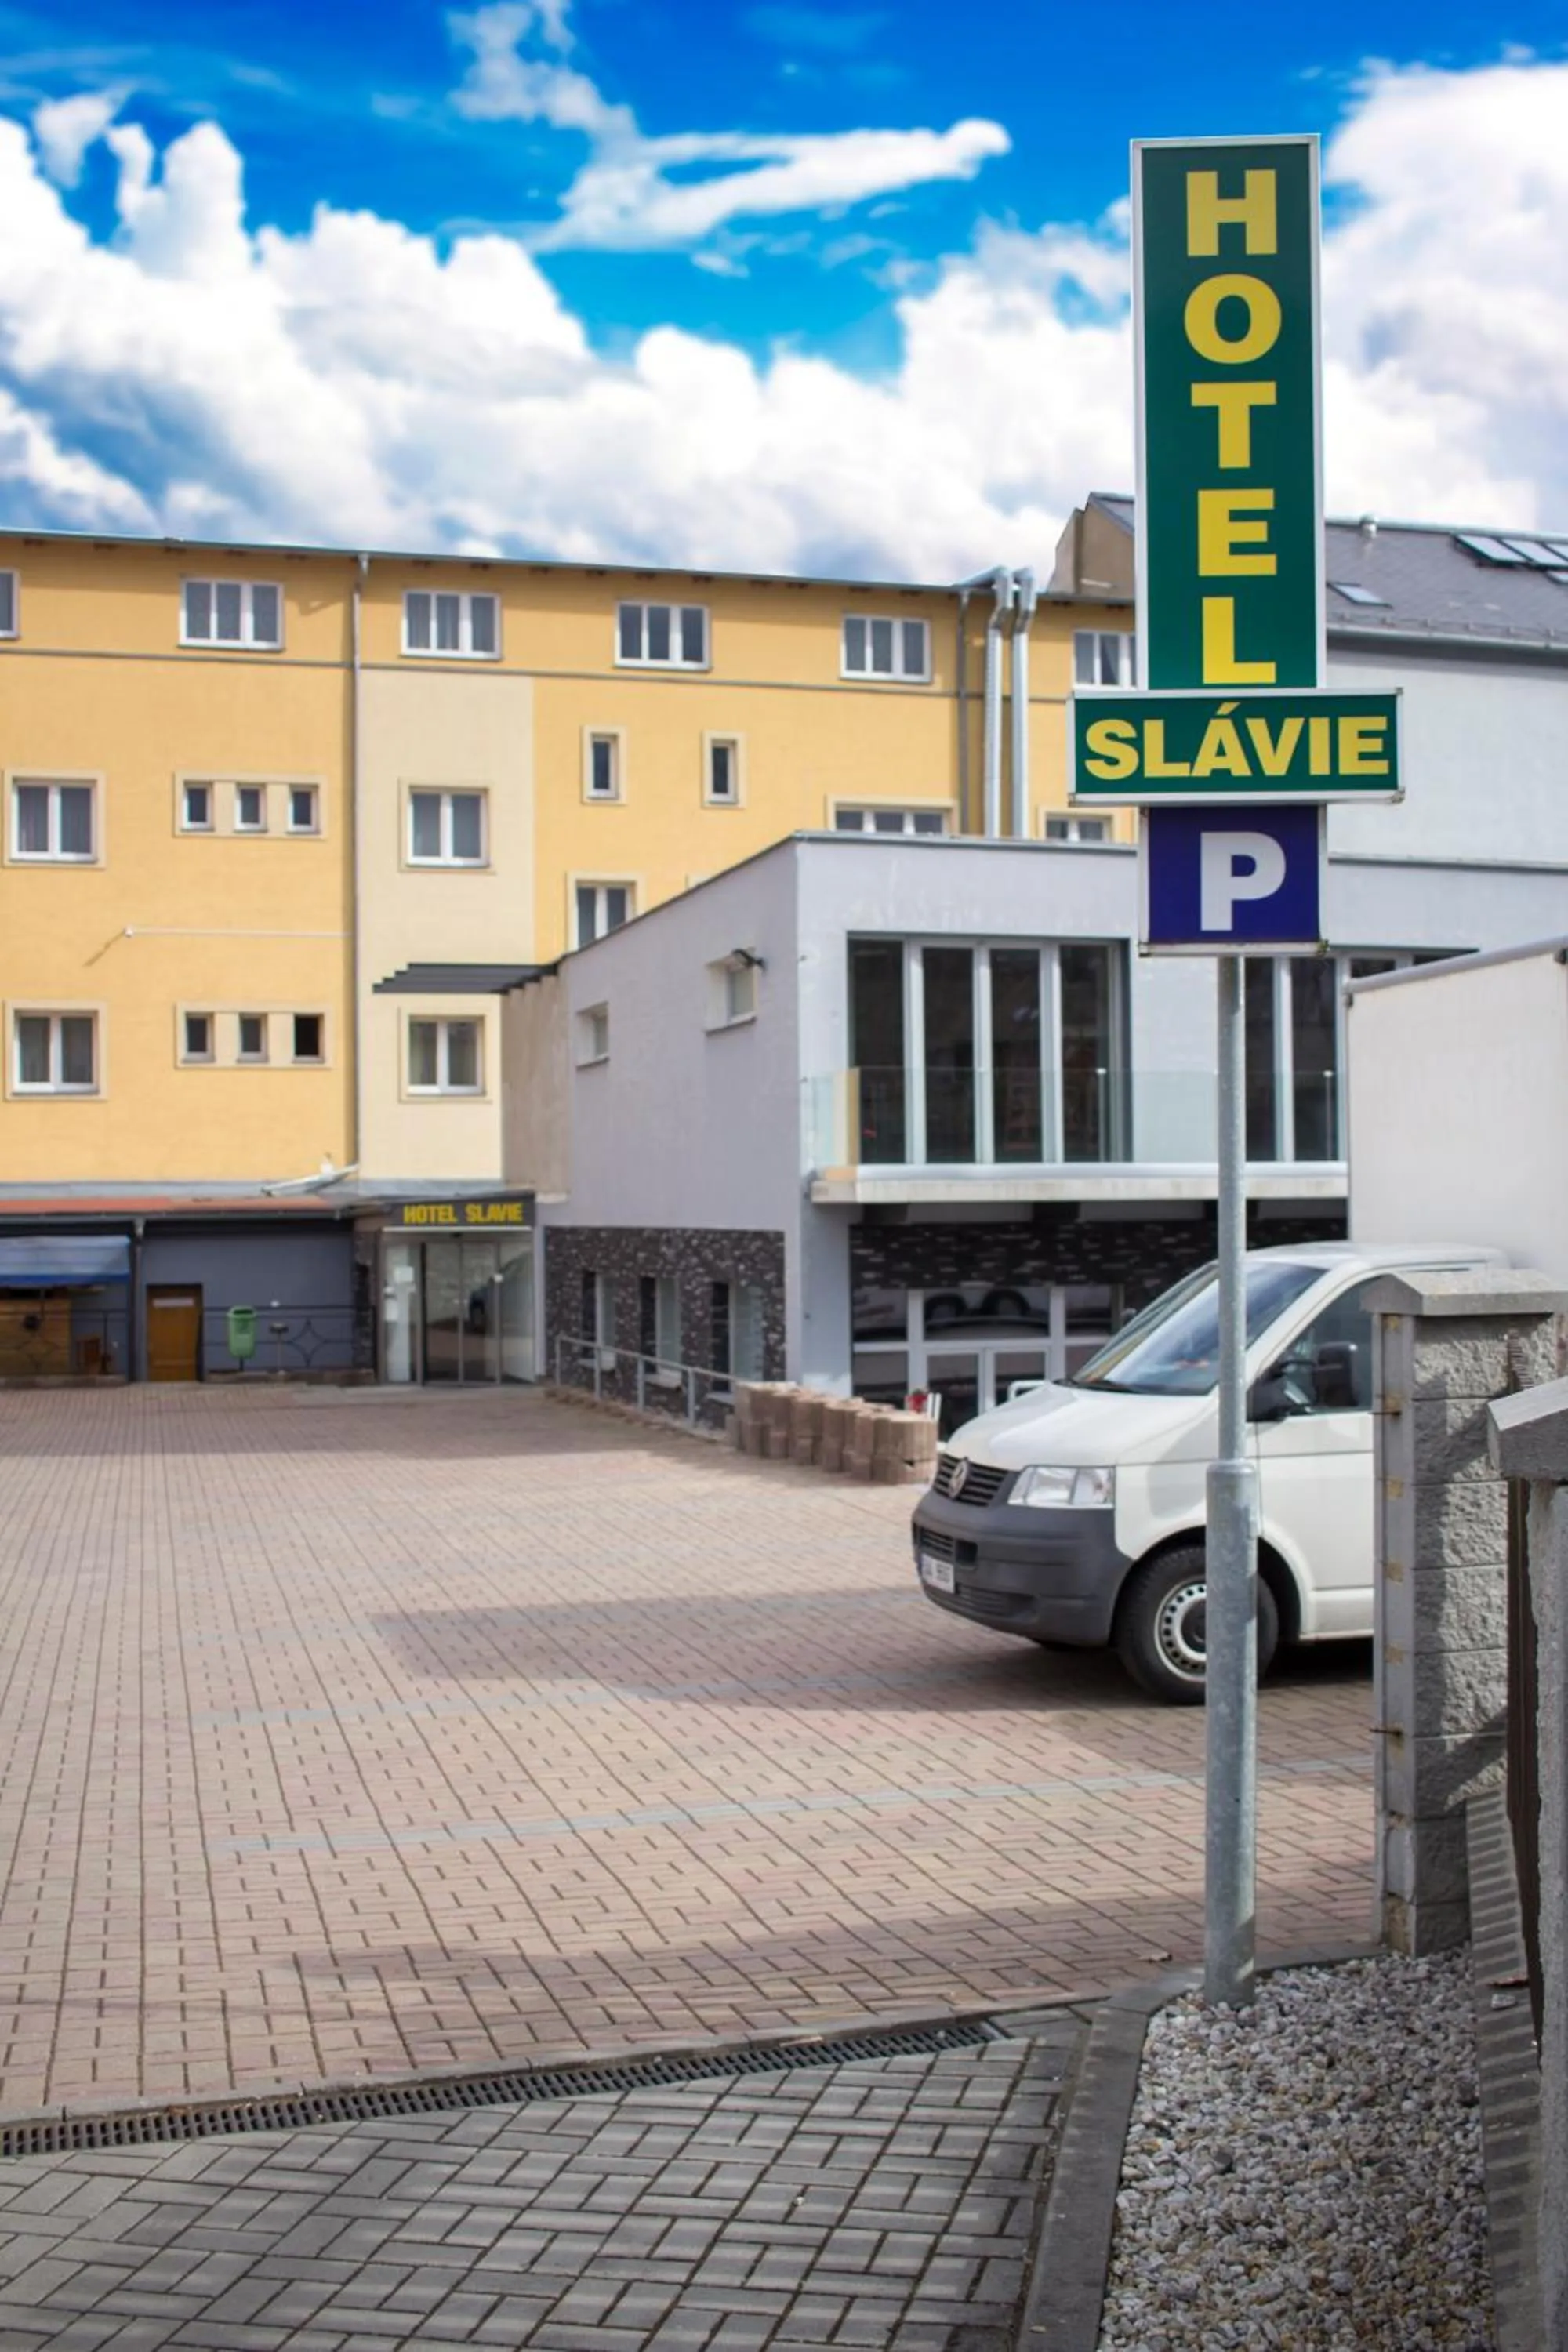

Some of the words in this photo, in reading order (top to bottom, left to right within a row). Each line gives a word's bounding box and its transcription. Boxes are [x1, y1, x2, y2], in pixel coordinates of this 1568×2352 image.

[1185, 169, 1281, 684] HOTEL
[1086, 702, 1389, 779] SLÁVIE
[1200, 831, 1287, 931] P
[403, 1204, 457, 1224] HOTEL
[465, 1202, 523, 1223] SLAVIE
